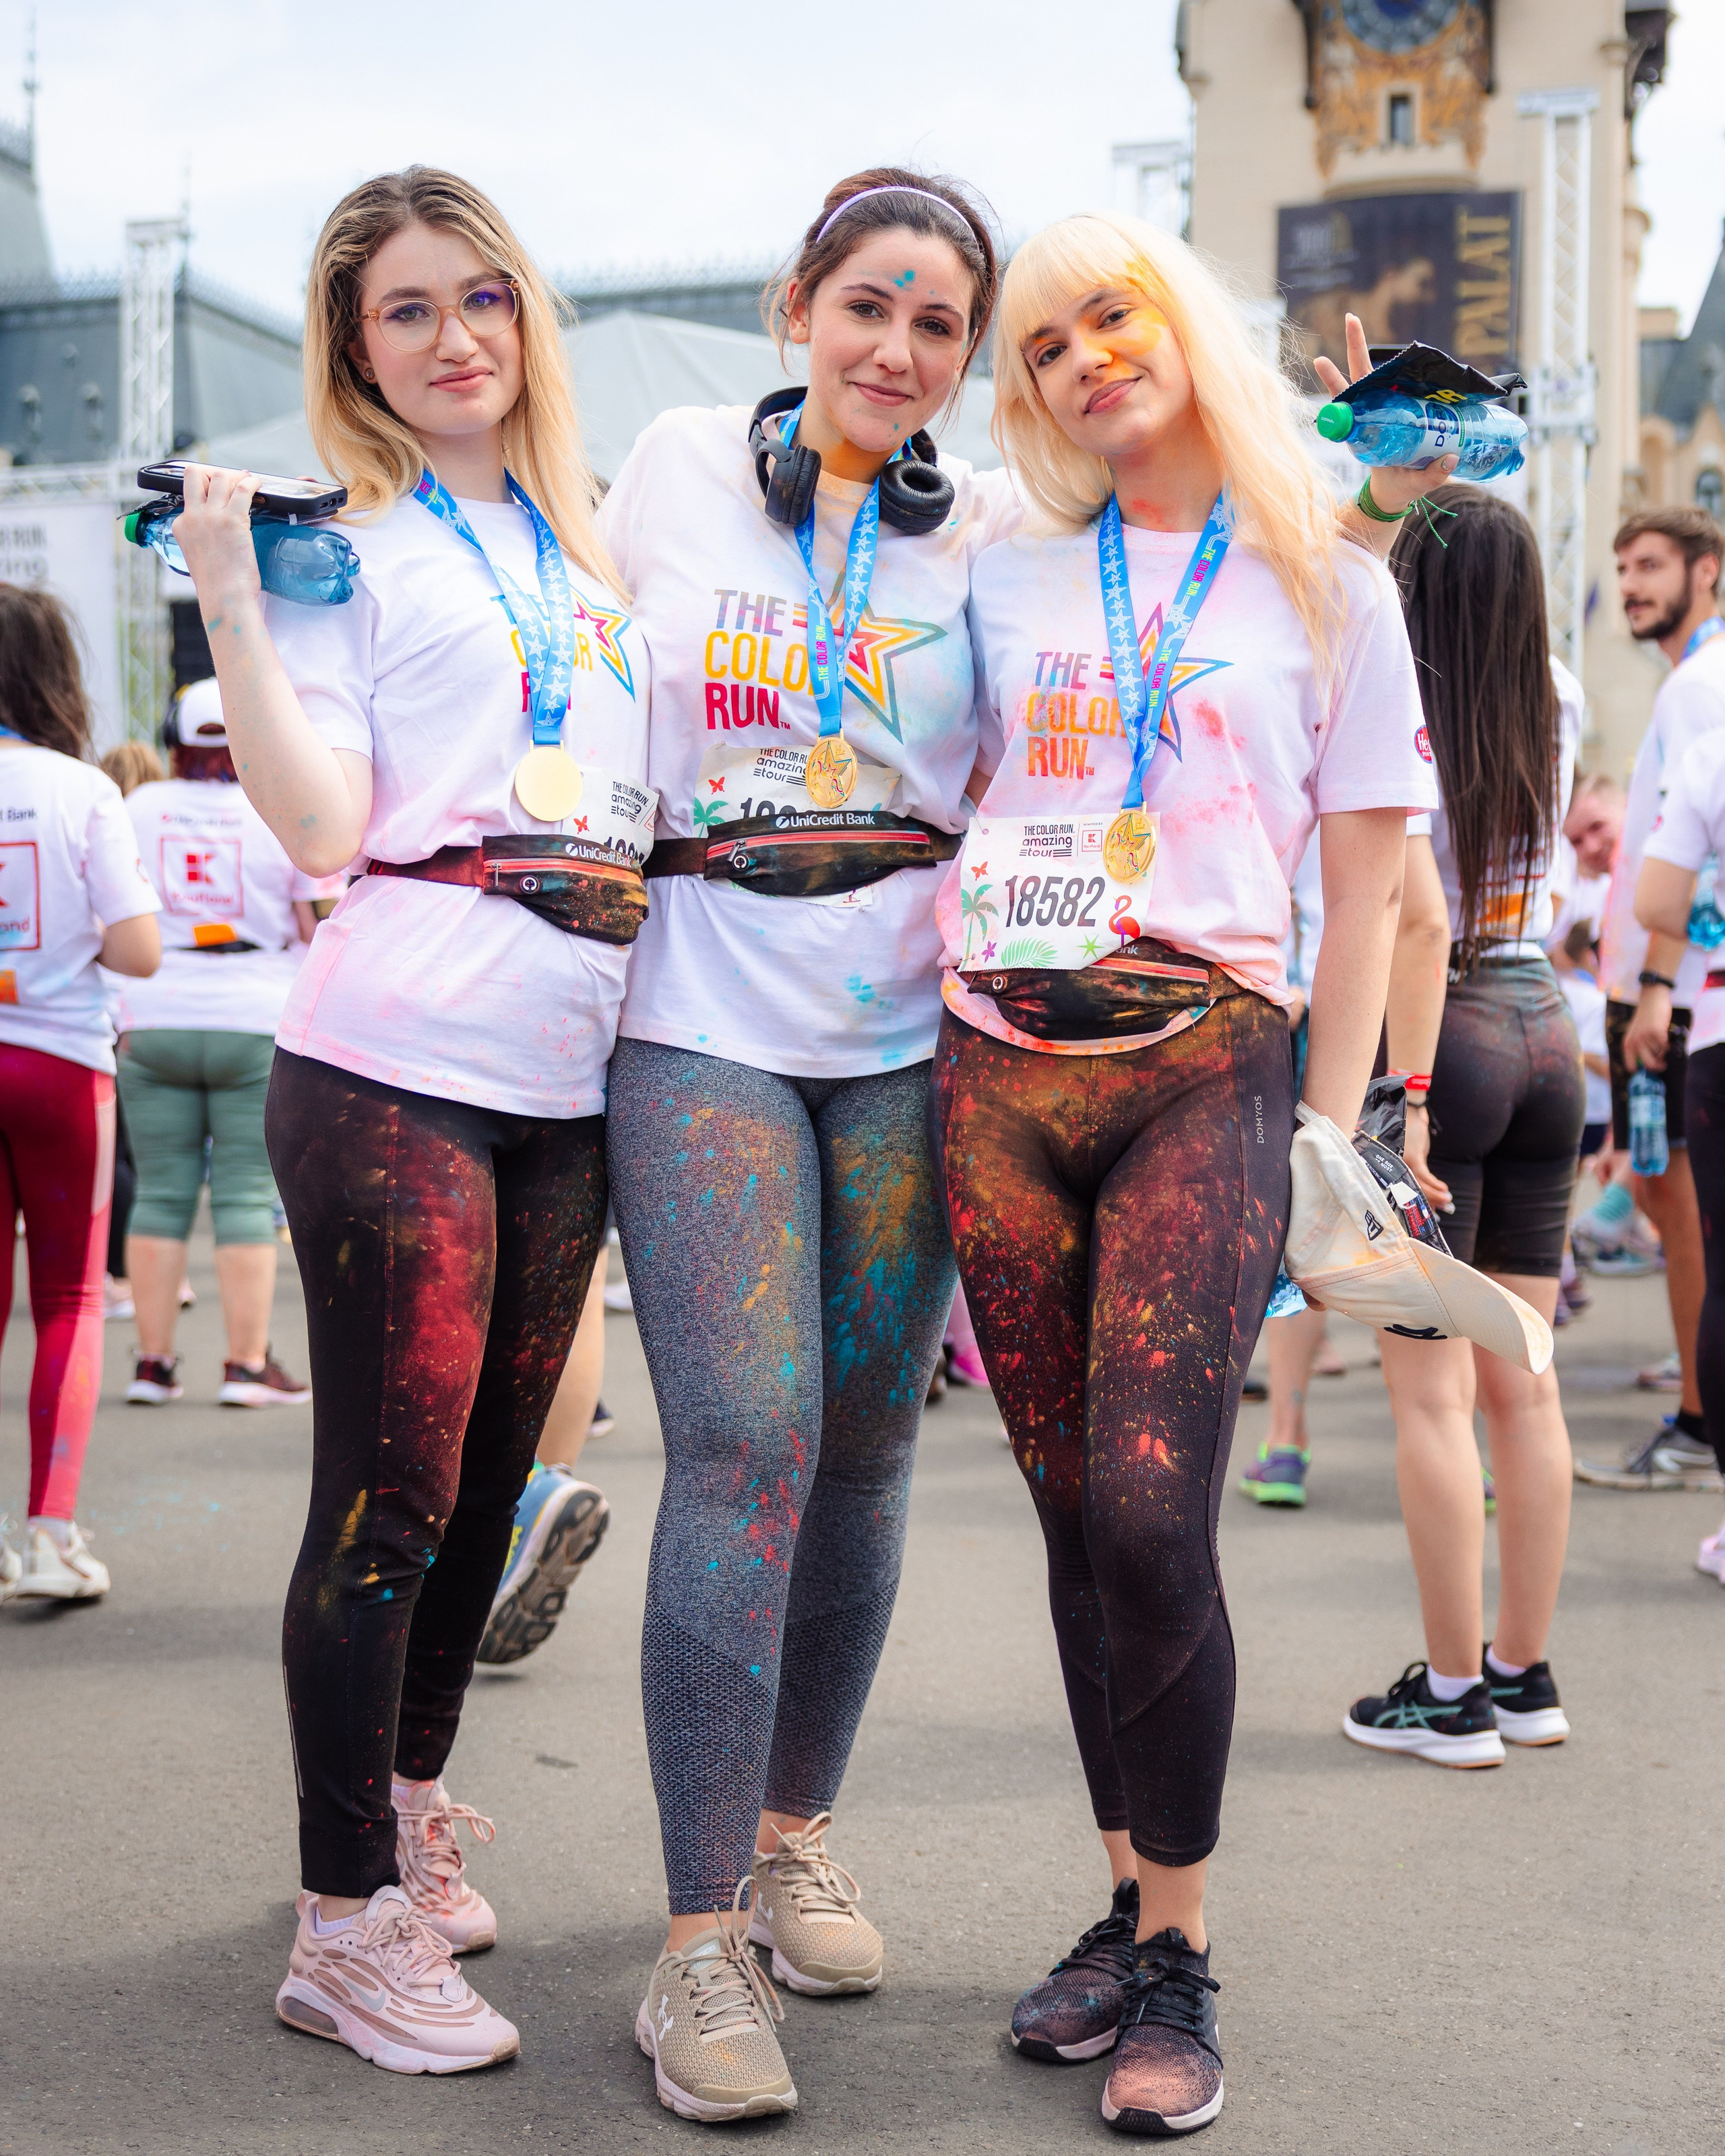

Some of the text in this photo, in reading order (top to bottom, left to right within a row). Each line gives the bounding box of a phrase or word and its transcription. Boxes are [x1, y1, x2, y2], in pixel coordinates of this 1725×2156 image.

[1185, 548, 1217, 597] THE COLOR RUN
[714, 589, 787, 637] THE
[815, 625, 829, 681] THE COLOR RUN
[705, 631, 815, 697] COLO
[1035, 652, 1092, 690] THE
[1148, 648, 1172, 707] THE COLOR RUN
[705, 683, 780, 730] RUN
[759, 749, 774, 757] THE
[774, 749, 799, 762] COLOR
[1028, 736, 1088, 780] RUN
[761, 769, 787, 782] tour
[613, 781, 623, 793] THE
[622, 784, 635, 798] COLOR
[611, 794, 641, 814] amazing
[790, 813, 875, 827] UniCredit Bank
[1024, 826, 1036, 835] THE
[1036, 825, 1059, 835] COLOR
[1022, 835, 1072, 848] amazing
[579, 845, 616, 864] UniCredit
[617, 852, 632, 868] Bank
[1028, 848, 1053, 858] tour
[1005, 875, 1105, 928] 18582
[1116, 945, 1138, 955] ank
[1254, 1096, 1264, 1143] DOMYOS
[1381, 1162, 1393, 1172] MOST
[1385, 1160, 1393, 1168] SIZE
